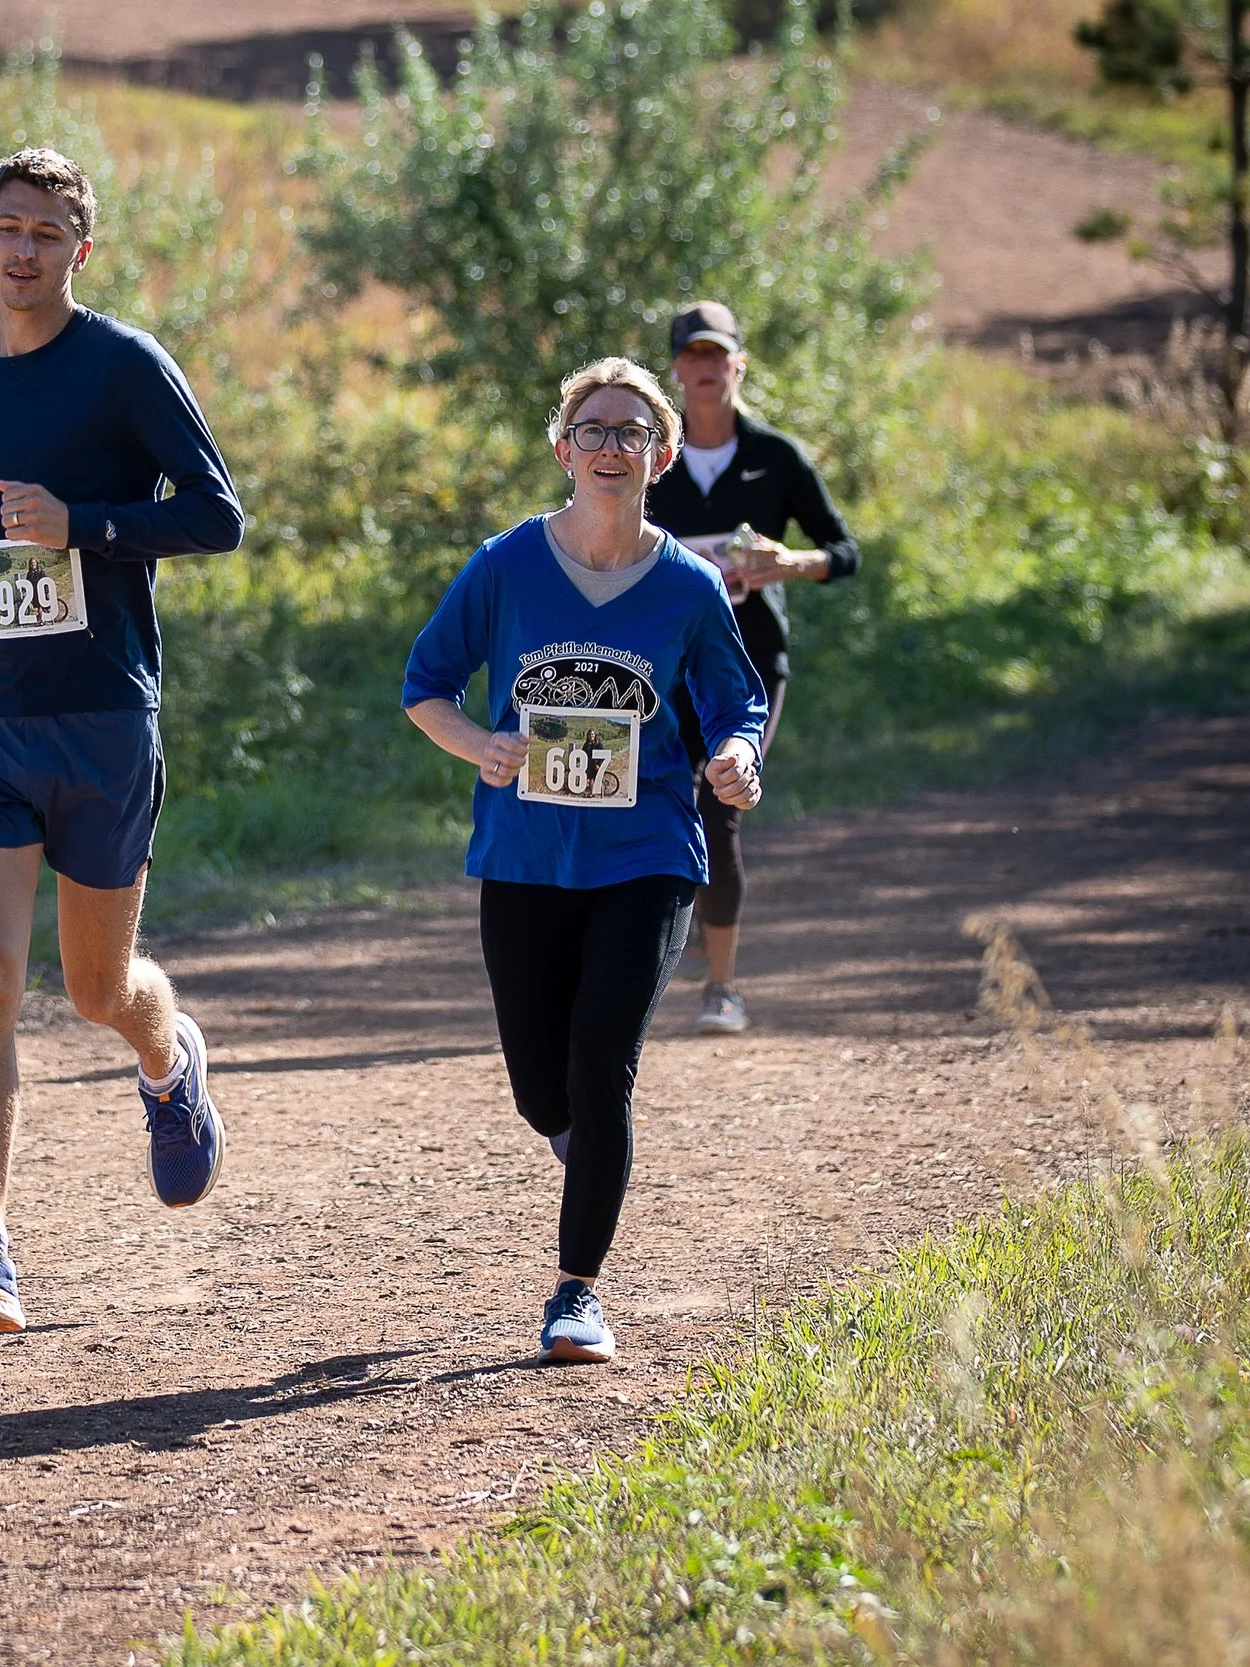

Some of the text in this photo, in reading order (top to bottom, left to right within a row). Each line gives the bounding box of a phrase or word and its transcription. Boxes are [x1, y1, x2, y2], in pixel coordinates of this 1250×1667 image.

[519, 650, 544, 666] Tom
[544, 641, 583, 657] Pfeifle
[584, 642, 641, 667] Memorial
[574, 662, 599, 673] 2021
[546, 747, 612, 794] 687
